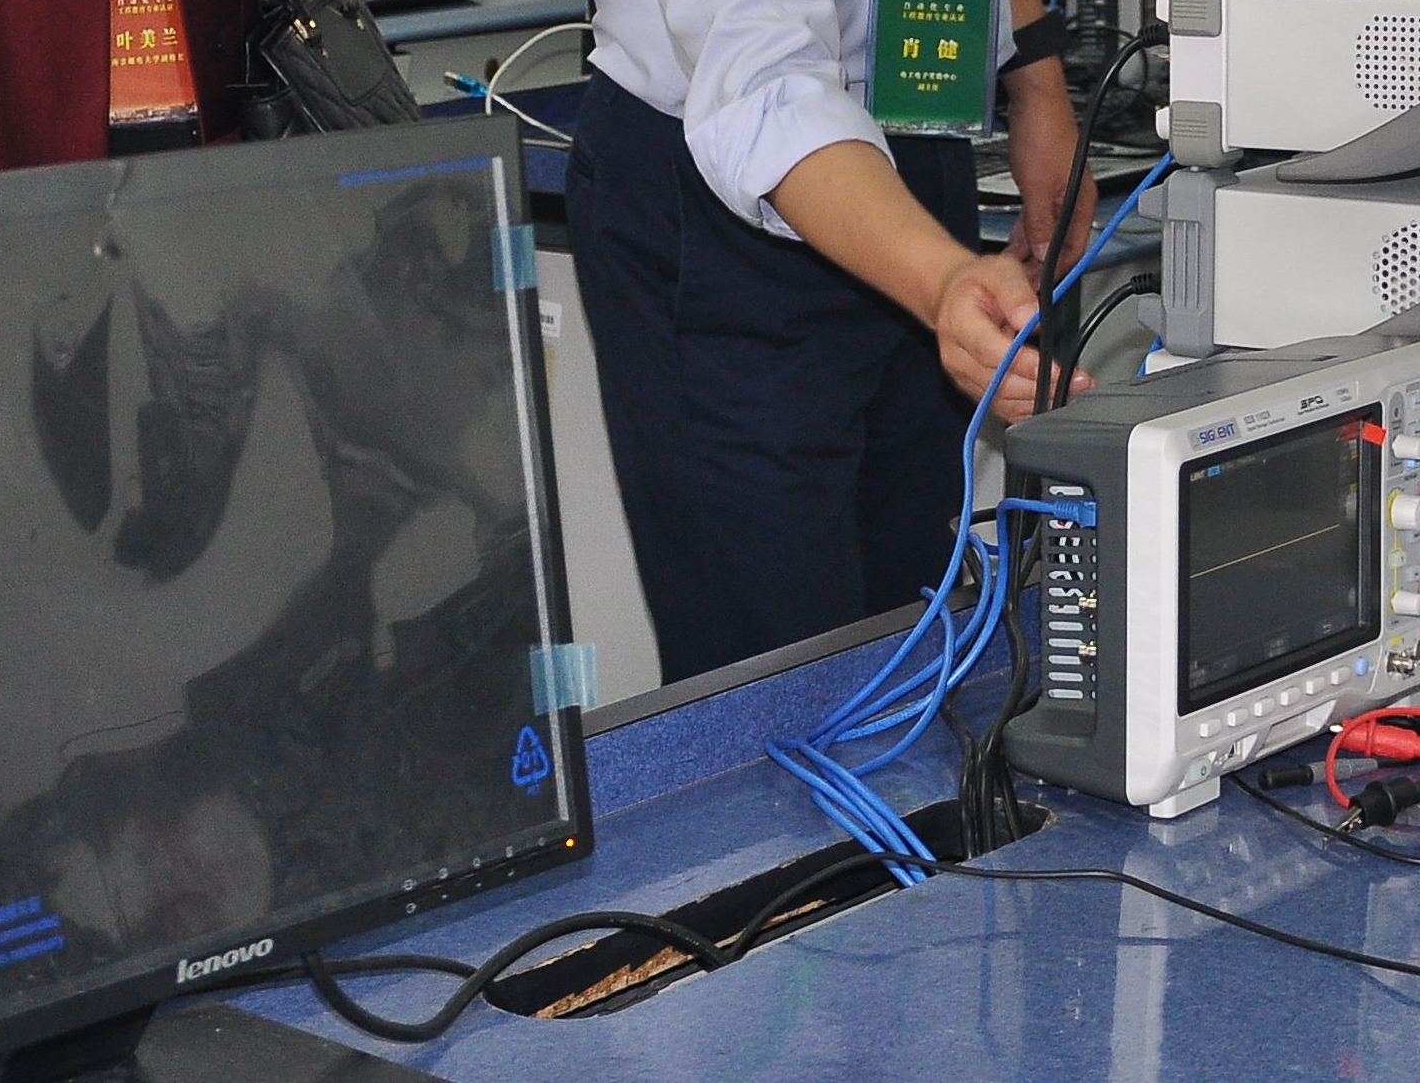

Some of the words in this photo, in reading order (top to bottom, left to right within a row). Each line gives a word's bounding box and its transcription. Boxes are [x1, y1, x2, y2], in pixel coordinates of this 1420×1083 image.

[116, 27, 178, 50] 叶美兰
[903, 37, 959, 59] 肖健
[1199, 423, 1235, 444] SIGLENT
[176, 938, 274, 984] lenovo
